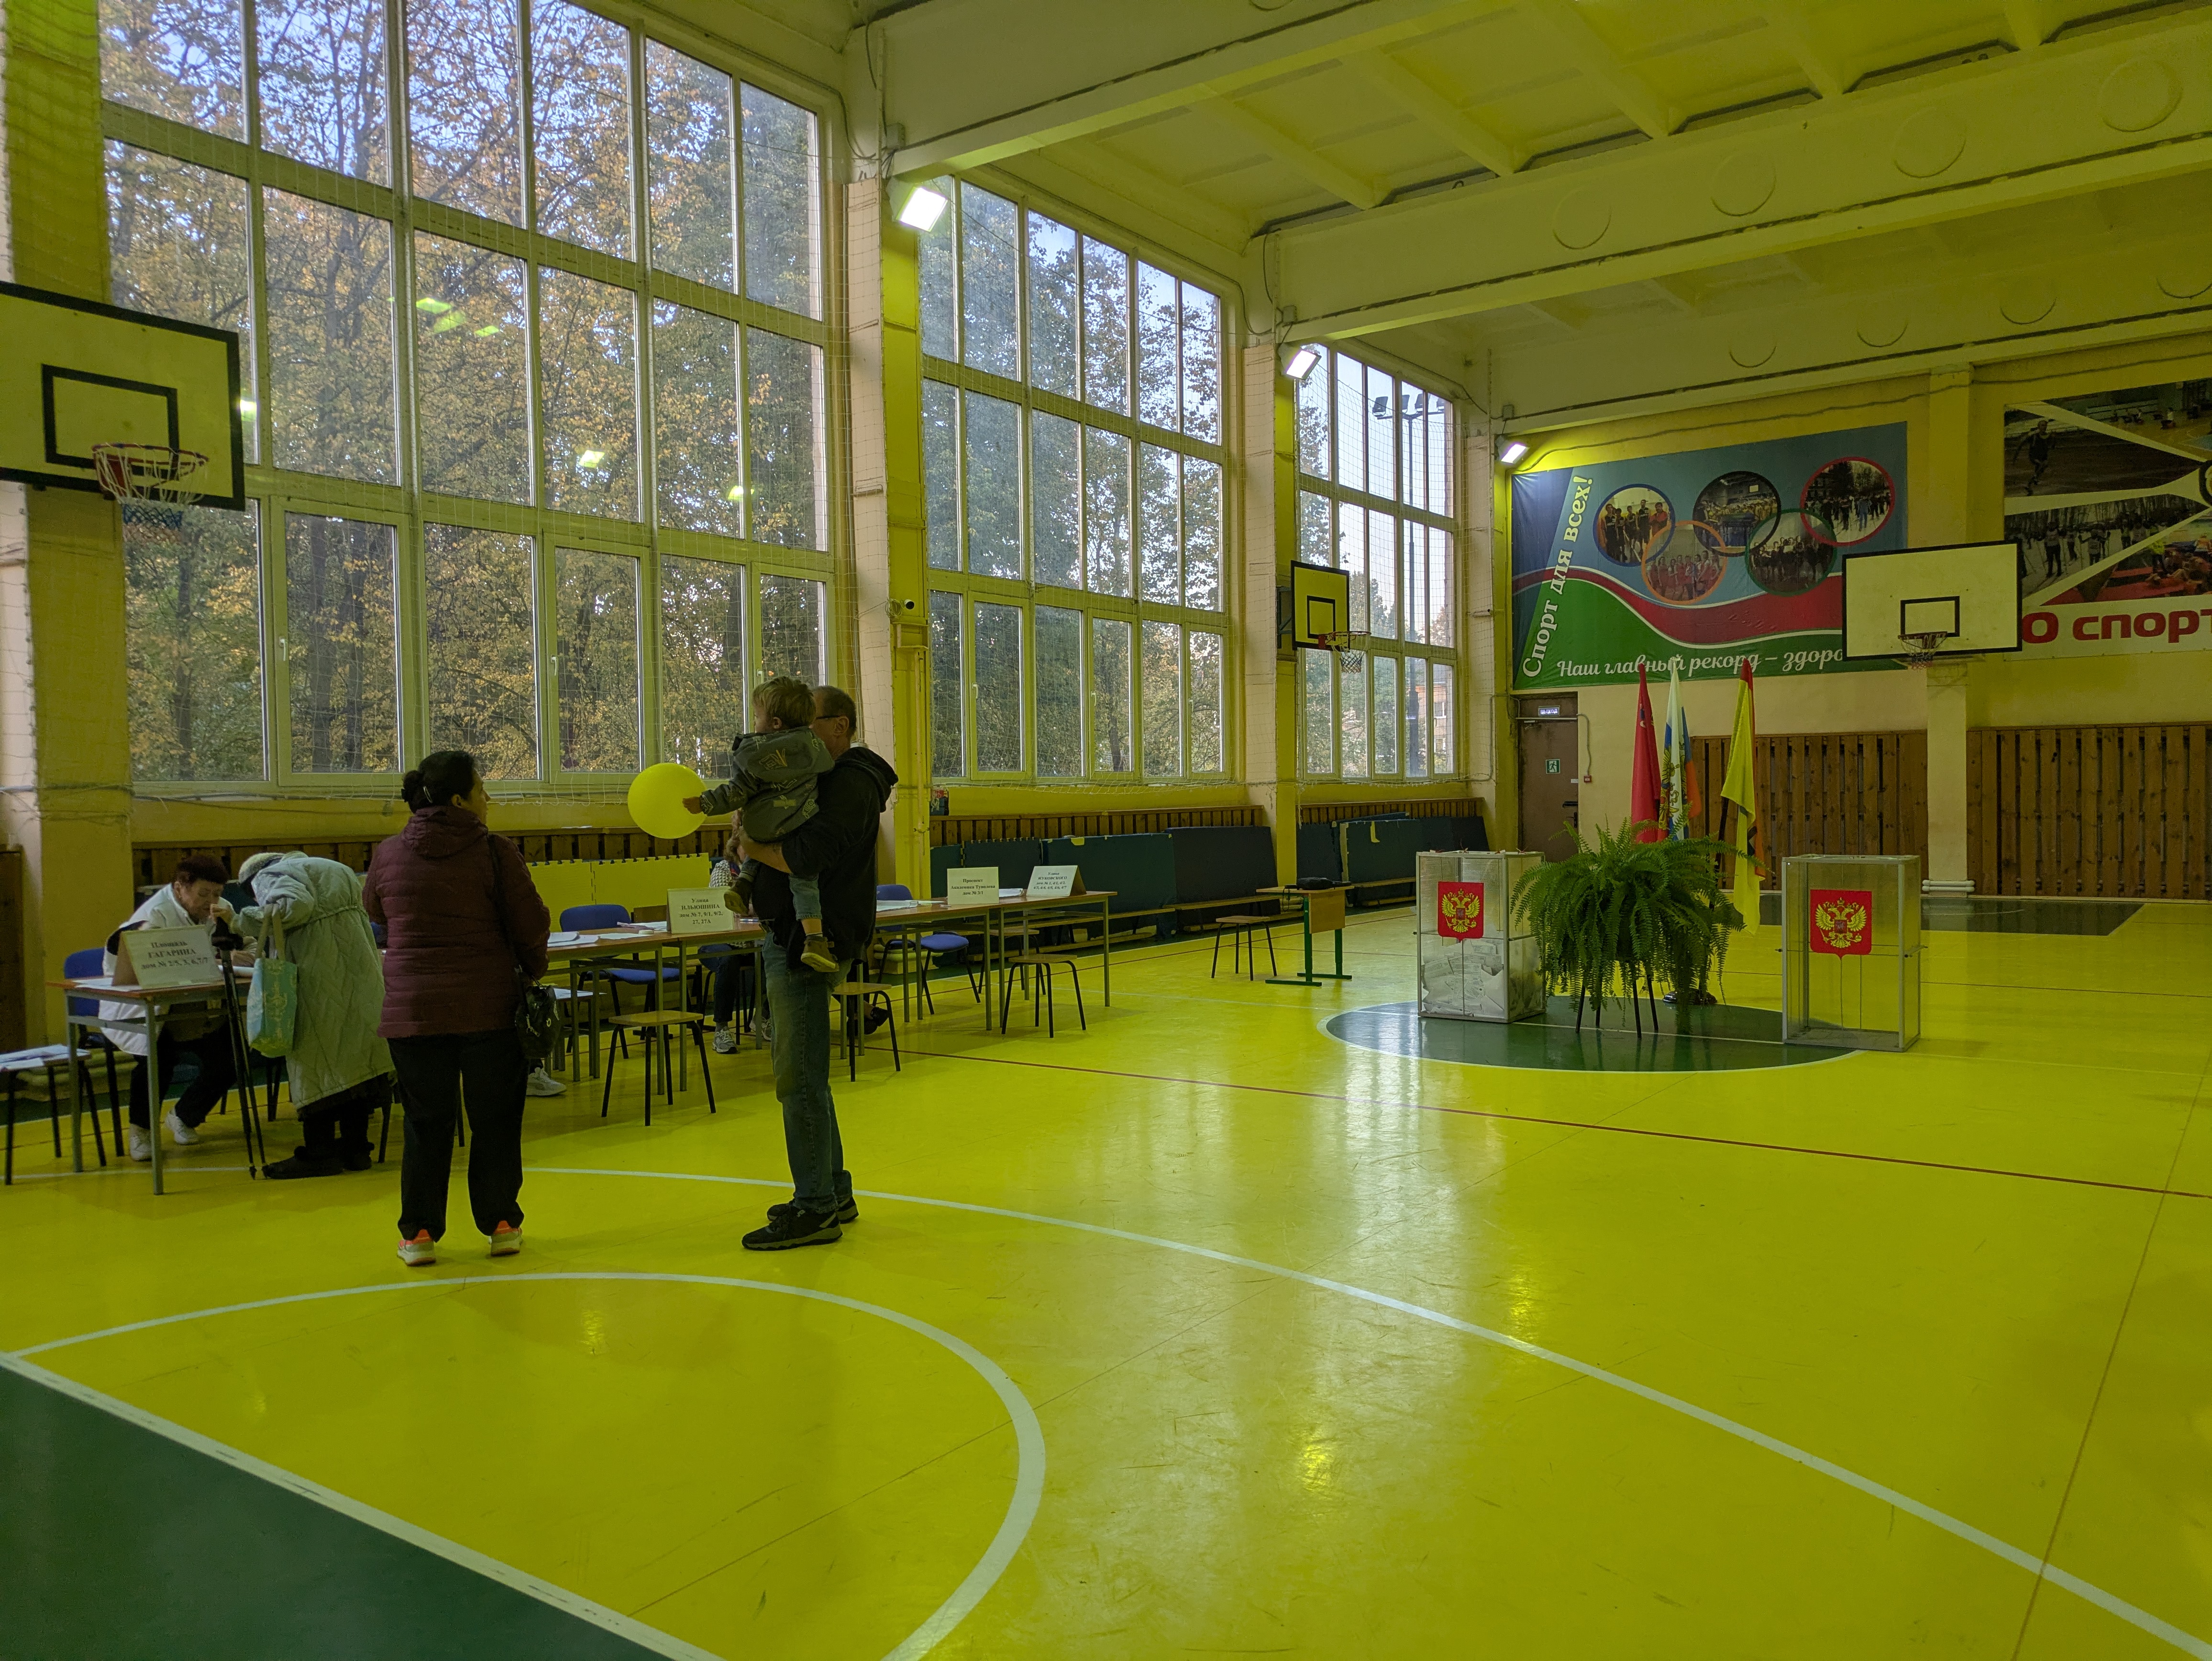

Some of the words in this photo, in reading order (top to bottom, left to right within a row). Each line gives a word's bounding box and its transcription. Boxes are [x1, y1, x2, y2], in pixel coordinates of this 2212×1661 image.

[1523, 600, 1558, 677] Спорт
[1550, 550, 1572, 595] для
[1563, 476, 1593, 543] всех!
[2022, 612, 2058, 643] О
[1557, 660, 1601, 677] Наш
[1604, 654, 1686, 674] главный
[1688, 653, 1761, 677] рекорд
[148, 949, 196, 958] ГАГАРИНА
